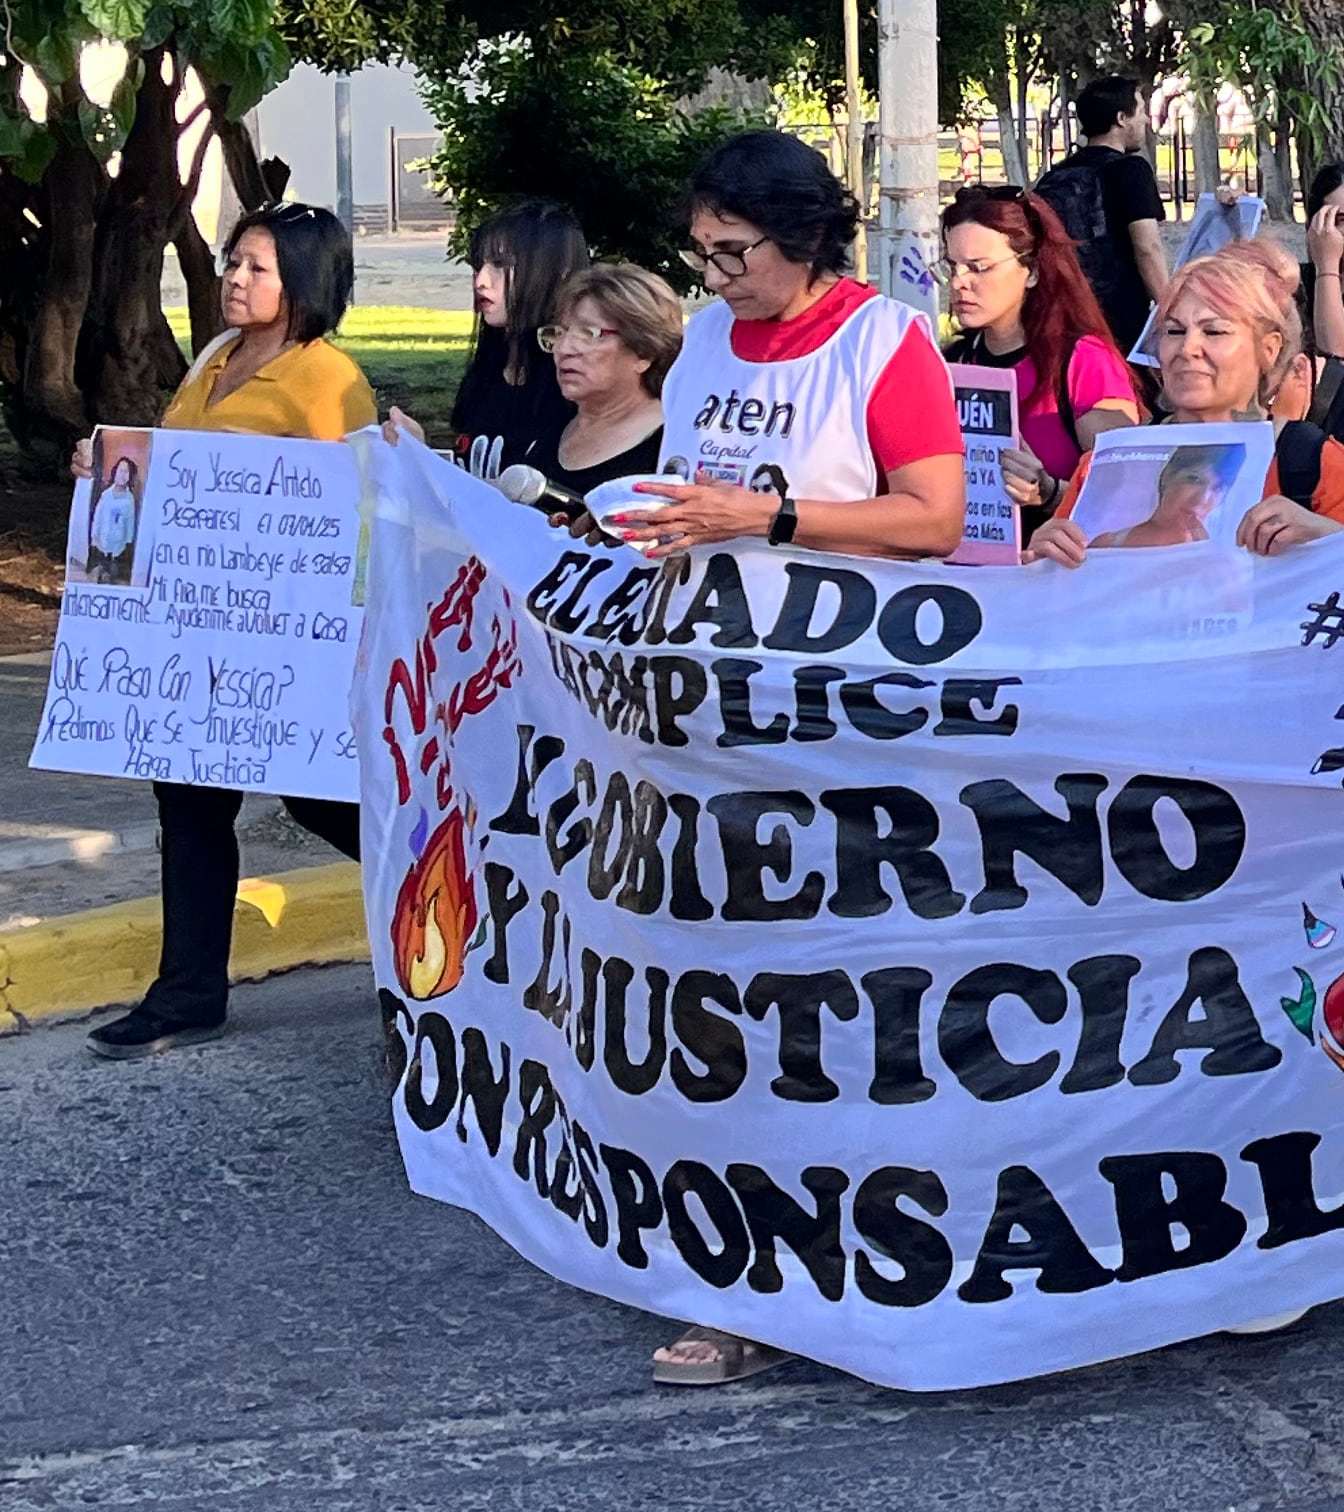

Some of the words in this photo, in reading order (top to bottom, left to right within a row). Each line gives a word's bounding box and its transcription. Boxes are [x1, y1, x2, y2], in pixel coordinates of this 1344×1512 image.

[693, 389, 796, 439] aten
[700, 439, 757, 461] Capital
[166, 449, 197, 503] Soy
[227, 580, 271, 612] busca
[527, 550, 613, 634] EL
[42, 696, 116, 745] Pedimos
[183, 748, 268, 784] Justicia
[545, 758, 1246, 921] GOBIERNO
[483, 861, 530, 985] Y
[576, 945, 1283, 1104] JUSTICIA
